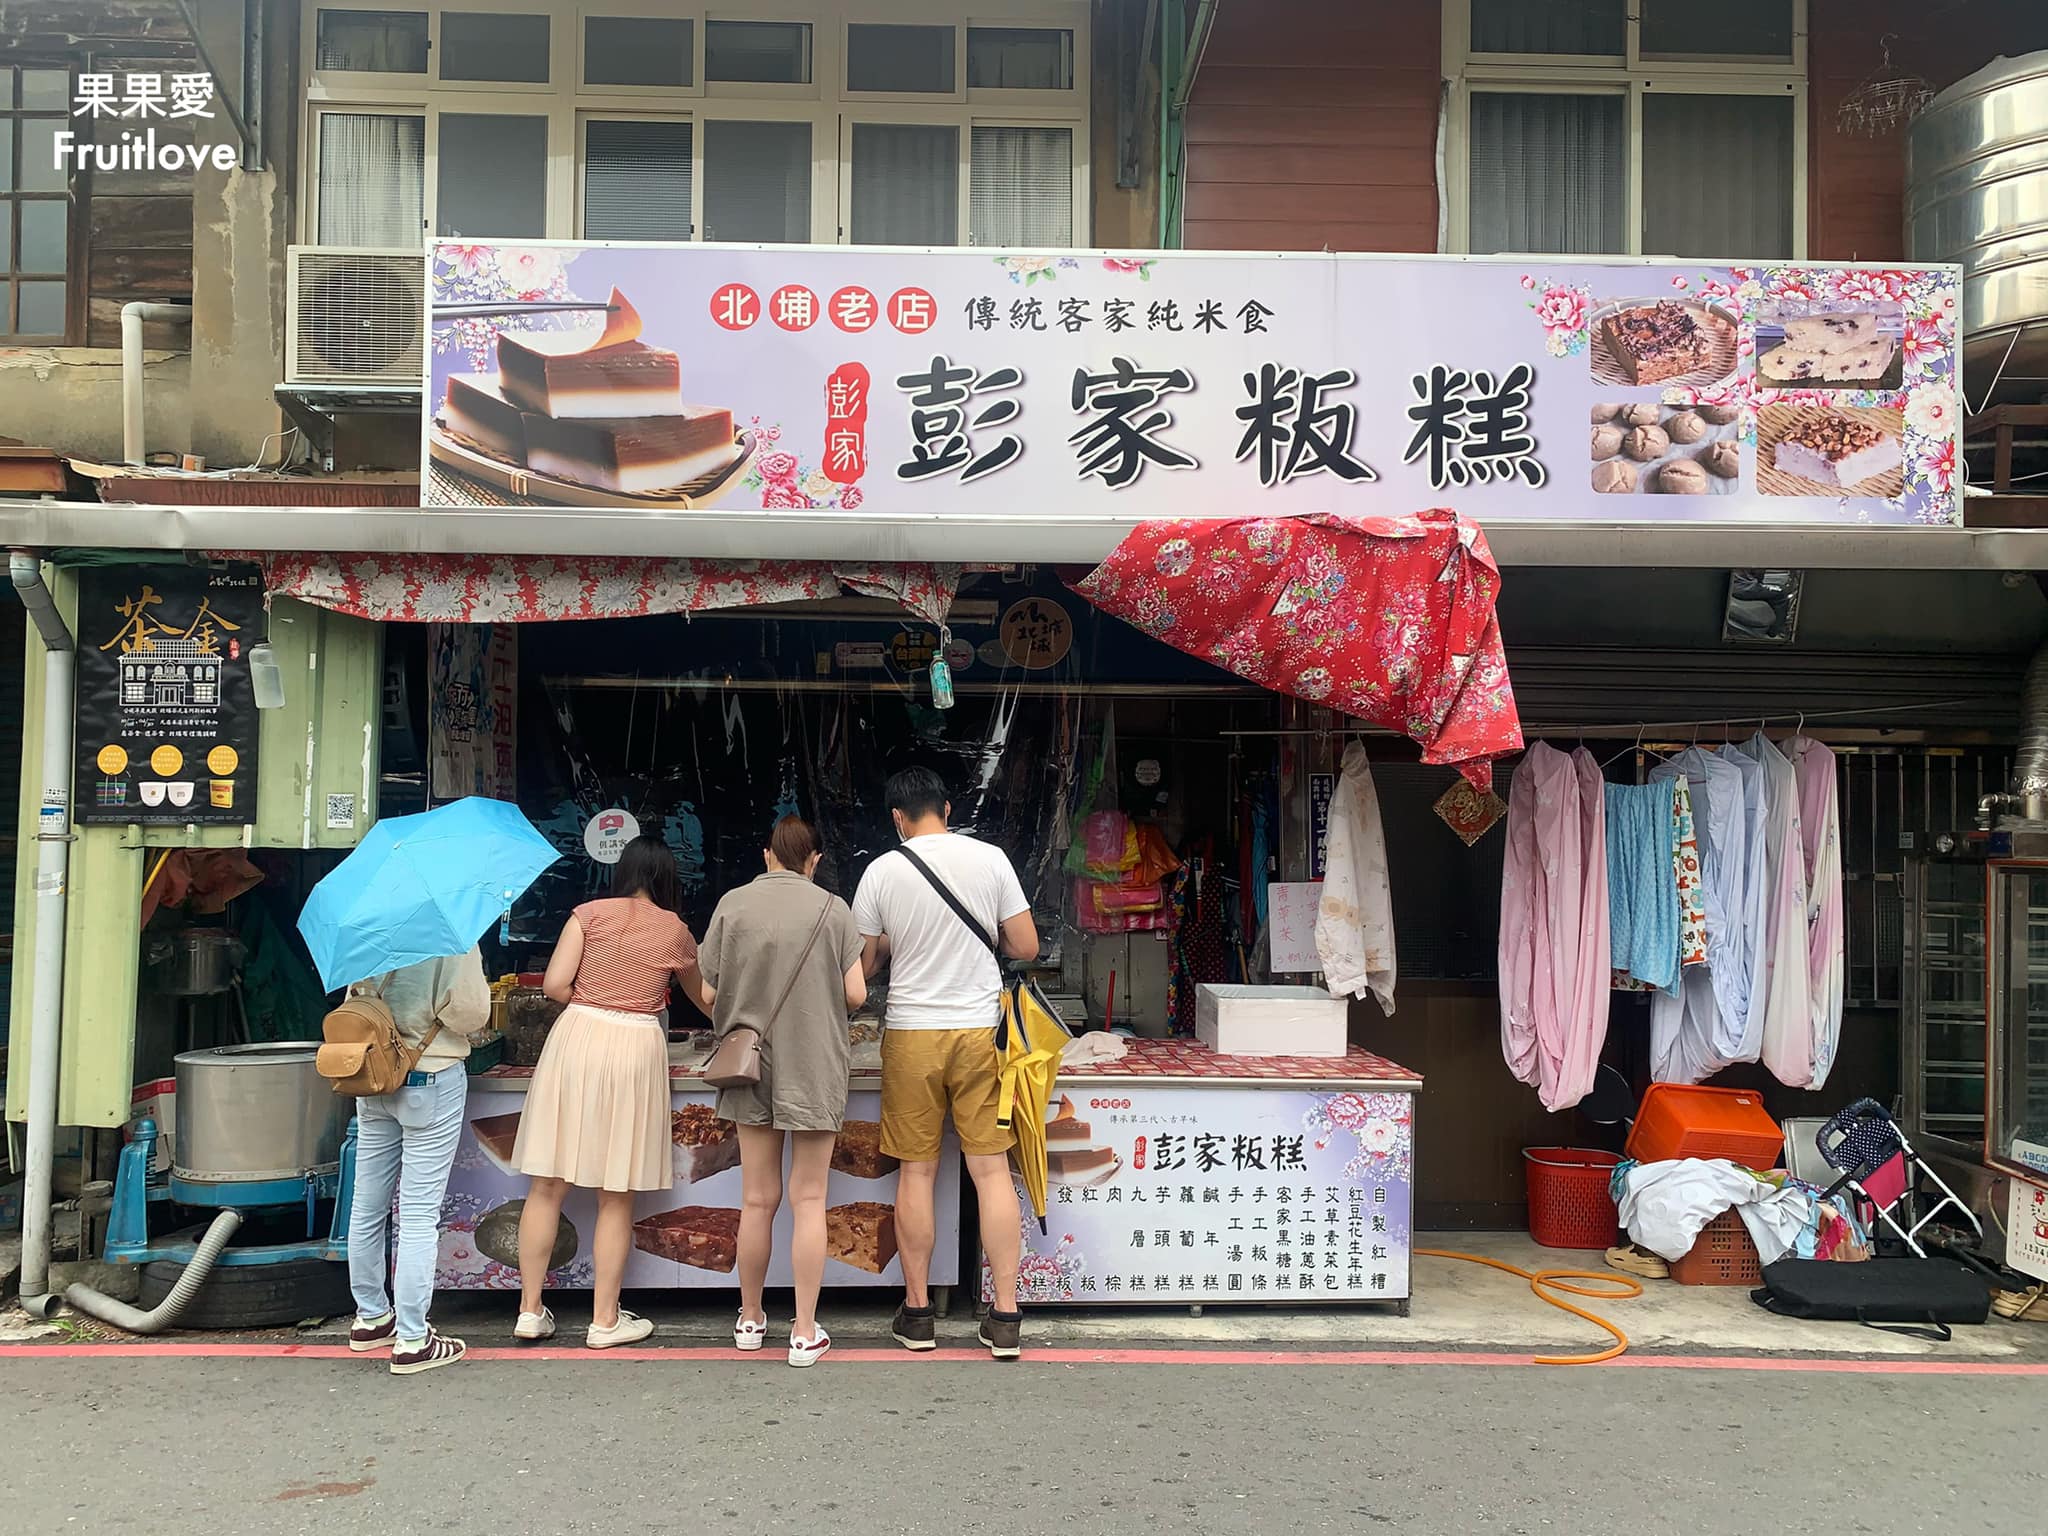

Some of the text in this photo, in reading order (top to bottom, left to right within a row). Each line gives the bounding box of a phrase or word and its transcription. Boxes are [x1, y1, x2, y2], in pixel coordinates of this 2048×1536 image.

[712, 284, 936, 334] 北埔老店
[964, 297, 1276, 335] 傳統客家純米食
[827, 372, 866, 475] 彭家
[895, 355, 1550, 489] 彭家粄糕
[99, 585, 241, 654] 茶金
[1152, 1131, 1308, 1174] 彭家粄糕
